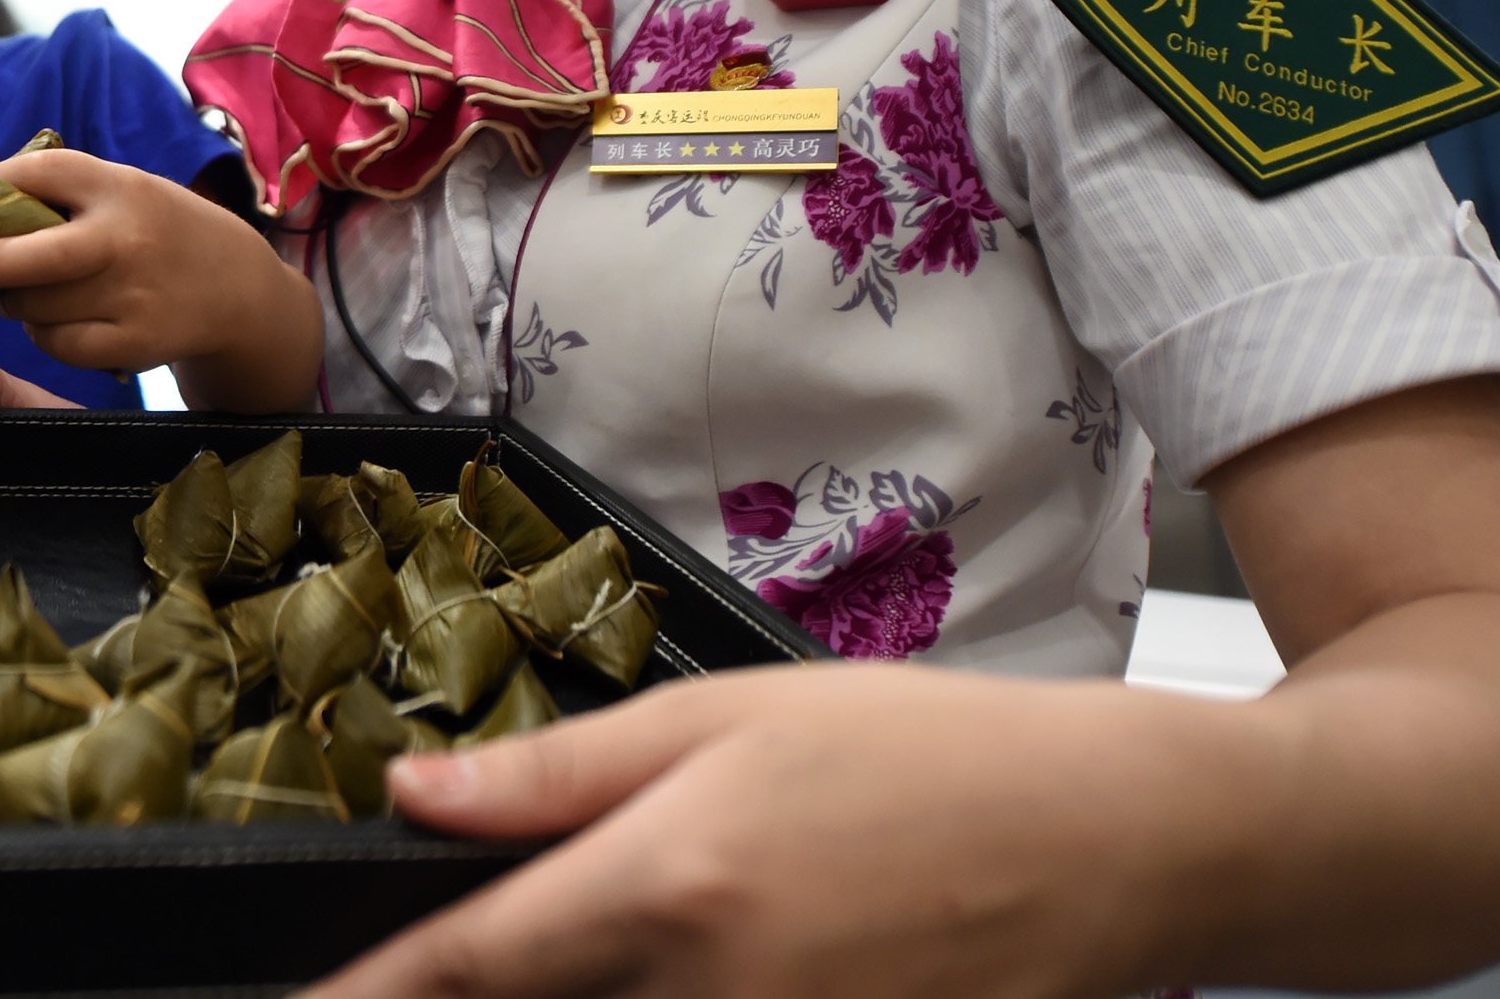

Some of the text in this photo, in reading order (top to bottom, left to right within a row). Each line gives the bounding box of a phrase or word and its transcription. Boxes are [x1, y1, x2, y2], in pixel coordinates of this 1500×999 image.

[1166, 31, 1375, 103] Chief Conductor
[1218, 80, 1316, 125] No.2634
[607, 137, 821, 160] 列车长 高灵巧
